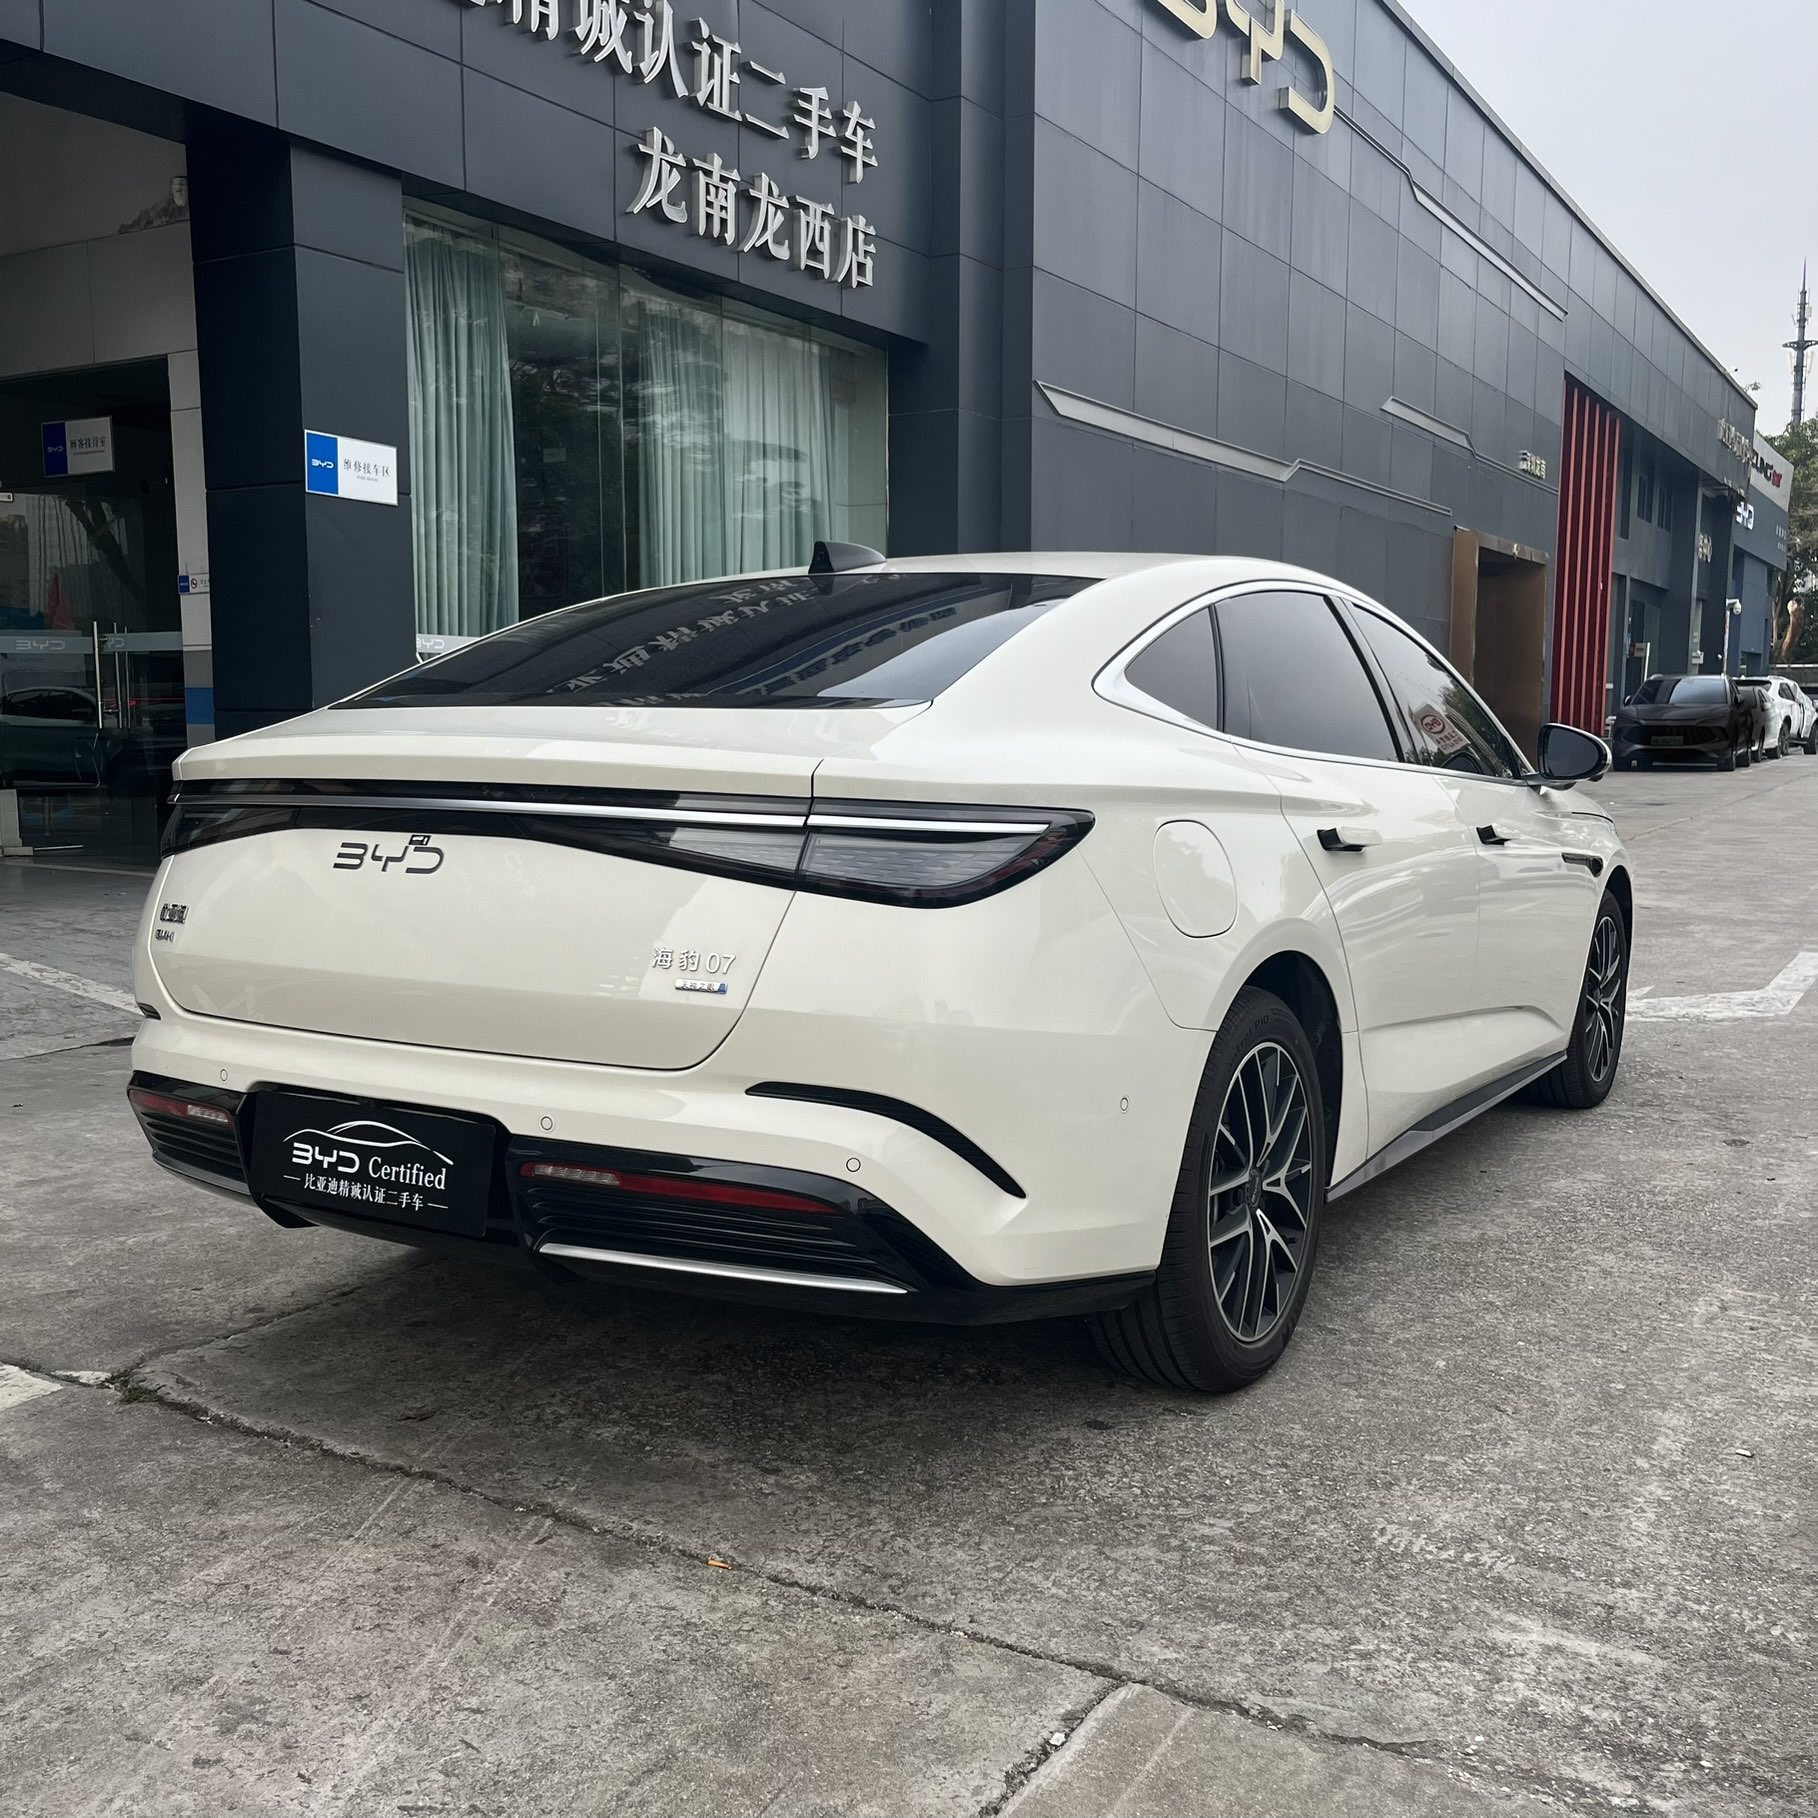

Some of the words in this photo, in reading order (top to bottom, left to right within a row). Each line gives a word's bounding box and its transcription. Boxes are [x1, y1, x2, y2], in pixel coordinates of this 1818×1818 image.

[626, 125, 877, 289] 龙南龙西店
[311, 458, 334, 470] BYD
[343, 458, 391, 478] 维修接车区
[16, 640, 66, 650] BYD
[333, 842, 445, 875] BYD
[651, 946, 701, 971] 海豹
[705, 952, 737, 975] 07
[291, 1142, 360, 1174] BYD
[368, 1156, 447, 1190] Certified
[304, 1172, 424, 1212] 比亚迪精诚认证二手车
